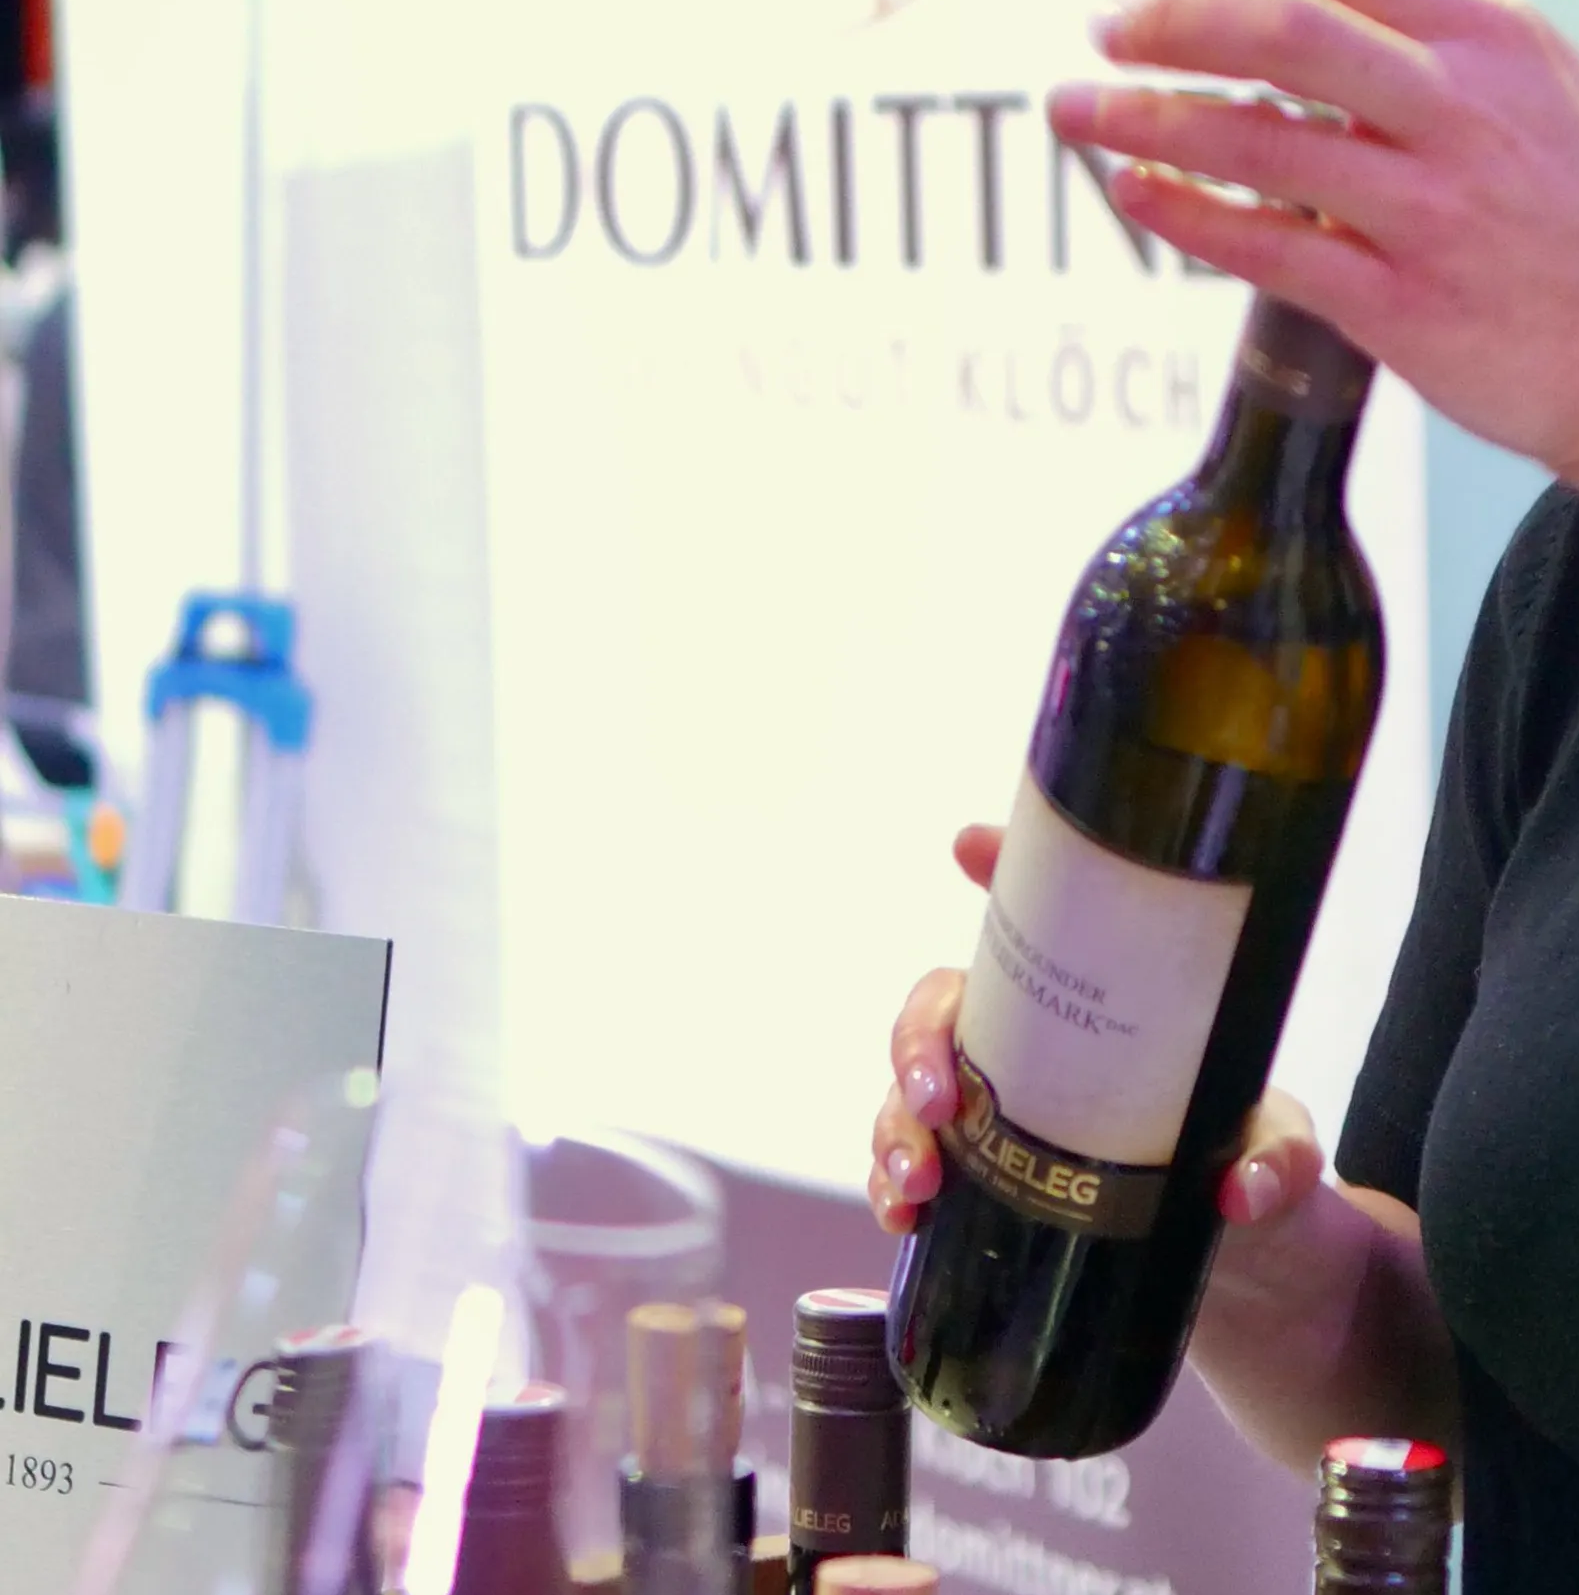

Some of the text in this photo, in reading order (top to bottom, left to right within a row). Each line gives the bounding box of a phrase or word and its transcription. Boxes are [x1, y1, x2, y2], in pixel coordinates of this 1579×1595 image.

[508, 90, 1230, 283] DOMITTN
[977, 1129, 1102, 1206] LIELEG
[0, 1318, 280, 1452] IELEG
[4, 1453, 75, 1496] 1893
